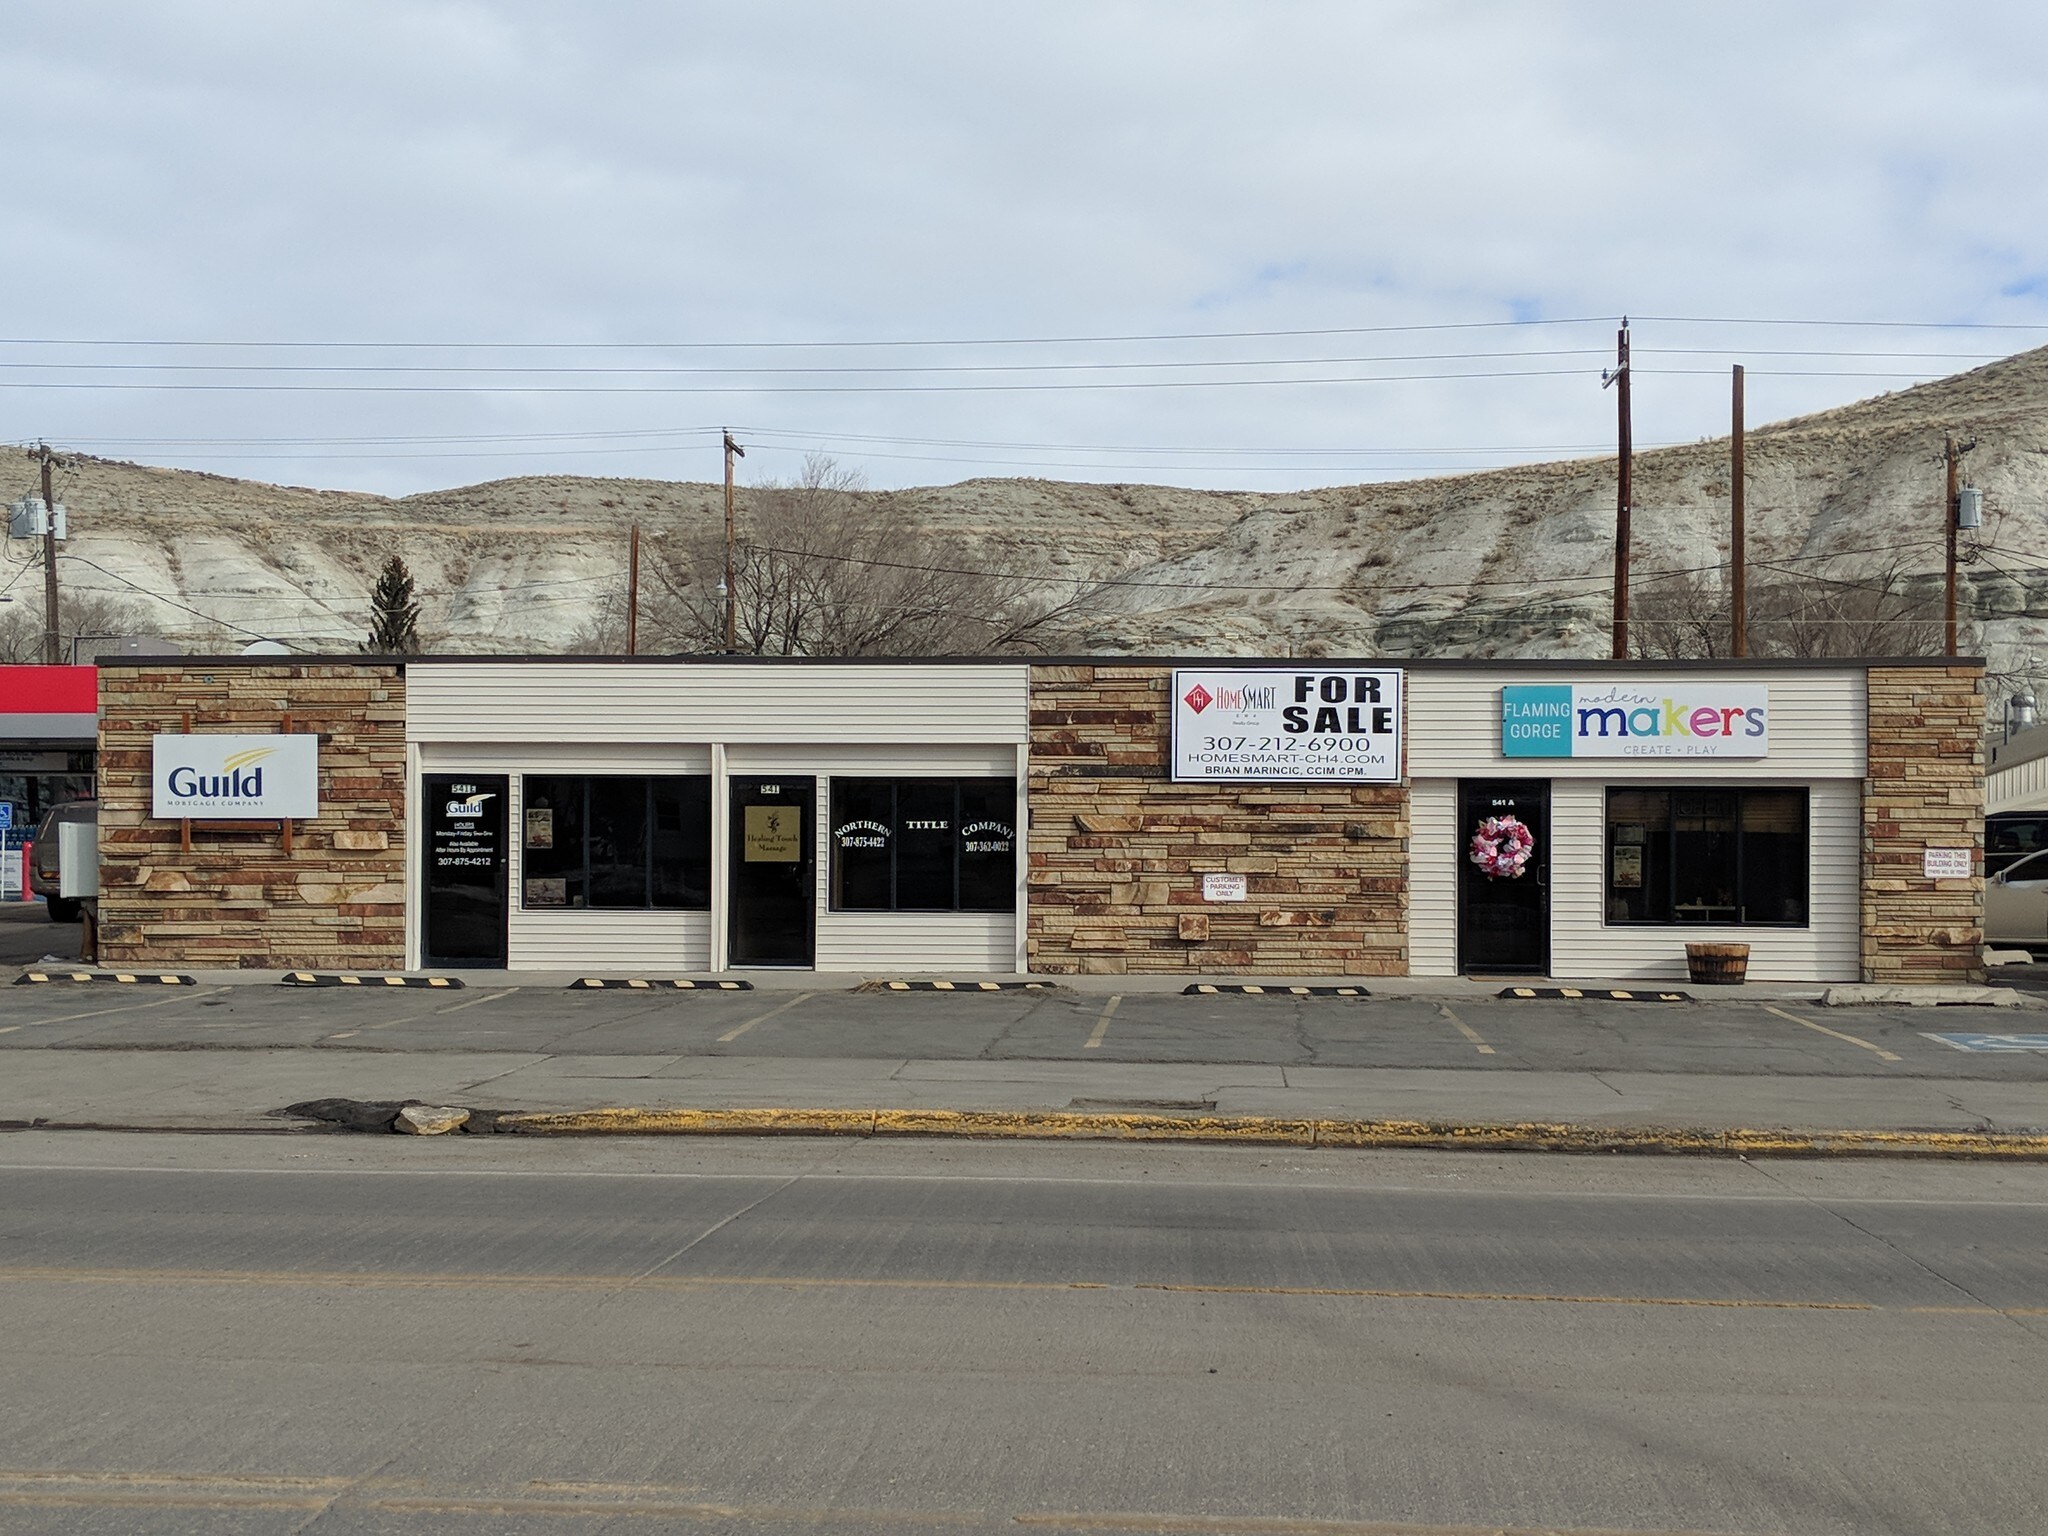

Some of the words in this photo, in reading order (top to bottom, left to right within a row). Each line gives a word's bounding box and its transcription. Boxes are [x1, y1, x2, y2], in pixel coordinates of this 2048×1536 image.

[1295, 676, 1381, 703] FOR
[1503, 703, 1570, 717] FLAMING
[1282, 706, 1393, 734] SALE
[1577, 699, 1765, 737] makers
[1510, 723, 1561, 738] GORGE
[1203, 737, 1370, 751] 307-212-6900
[1624, 745, 1671, 755] CREATE
[1686, 745, 1718, 755] PLAY
[1188, 754, 1385, 764] HOMESMART-CH4.COM
[1205, 766, 1240, 775] BRIAN
[1306, 767, 1335, 775] CCIM
[168, 767, 262, 797] Guild
[762, 785, 778, 793] 541
[447, 802, 481, 813] Guild
[834, 820, 892, 838] NORTHERN
[906, 820, 949, 829] TITLE
[961, 821, 1015, 840] COMPANY
[747, 834, 775, 843] Healing
[841, 836, 885, 847] 307-875-4422
[438, 857, 491, 866] 307-875-4212
